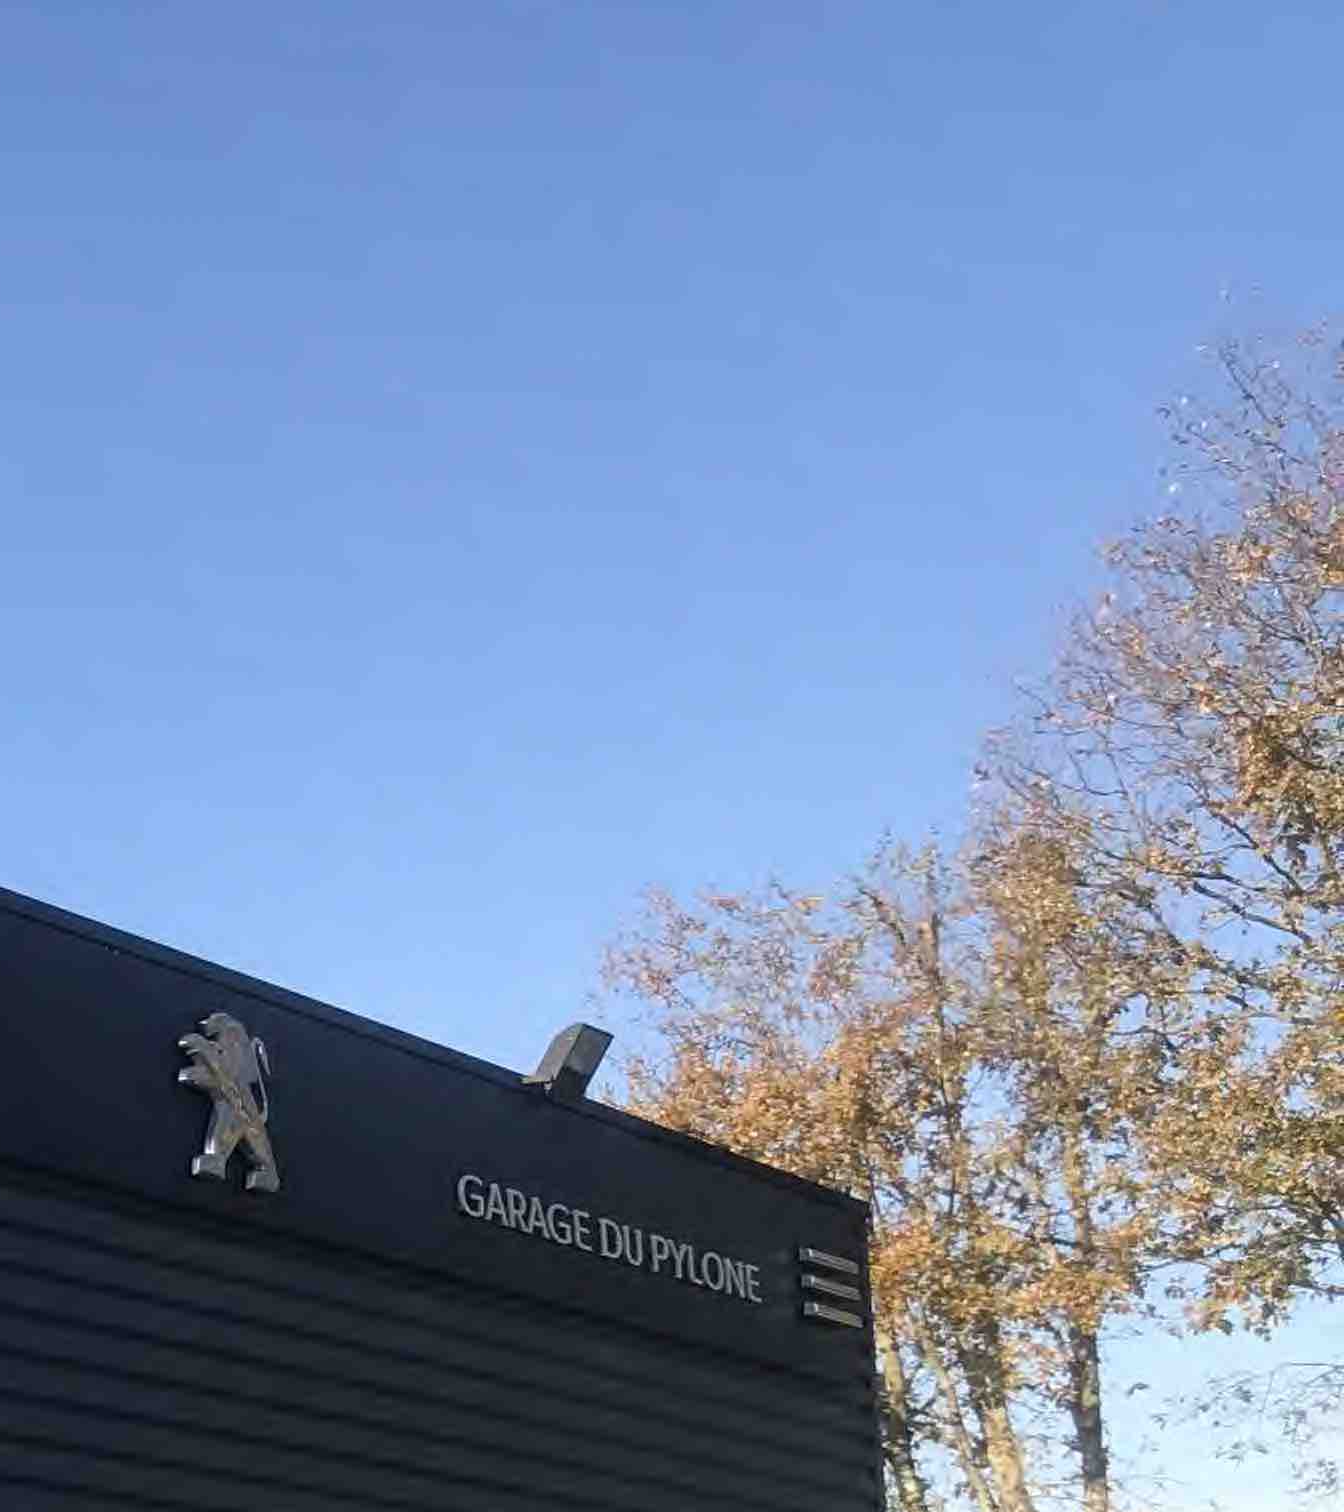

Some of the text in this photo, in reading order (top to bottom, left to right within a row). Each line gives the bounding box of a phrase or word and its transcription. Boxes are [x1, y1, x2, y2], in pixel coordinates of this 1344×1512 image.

[457, 1174, 762, 1302] GARAGE DU PYLONE
